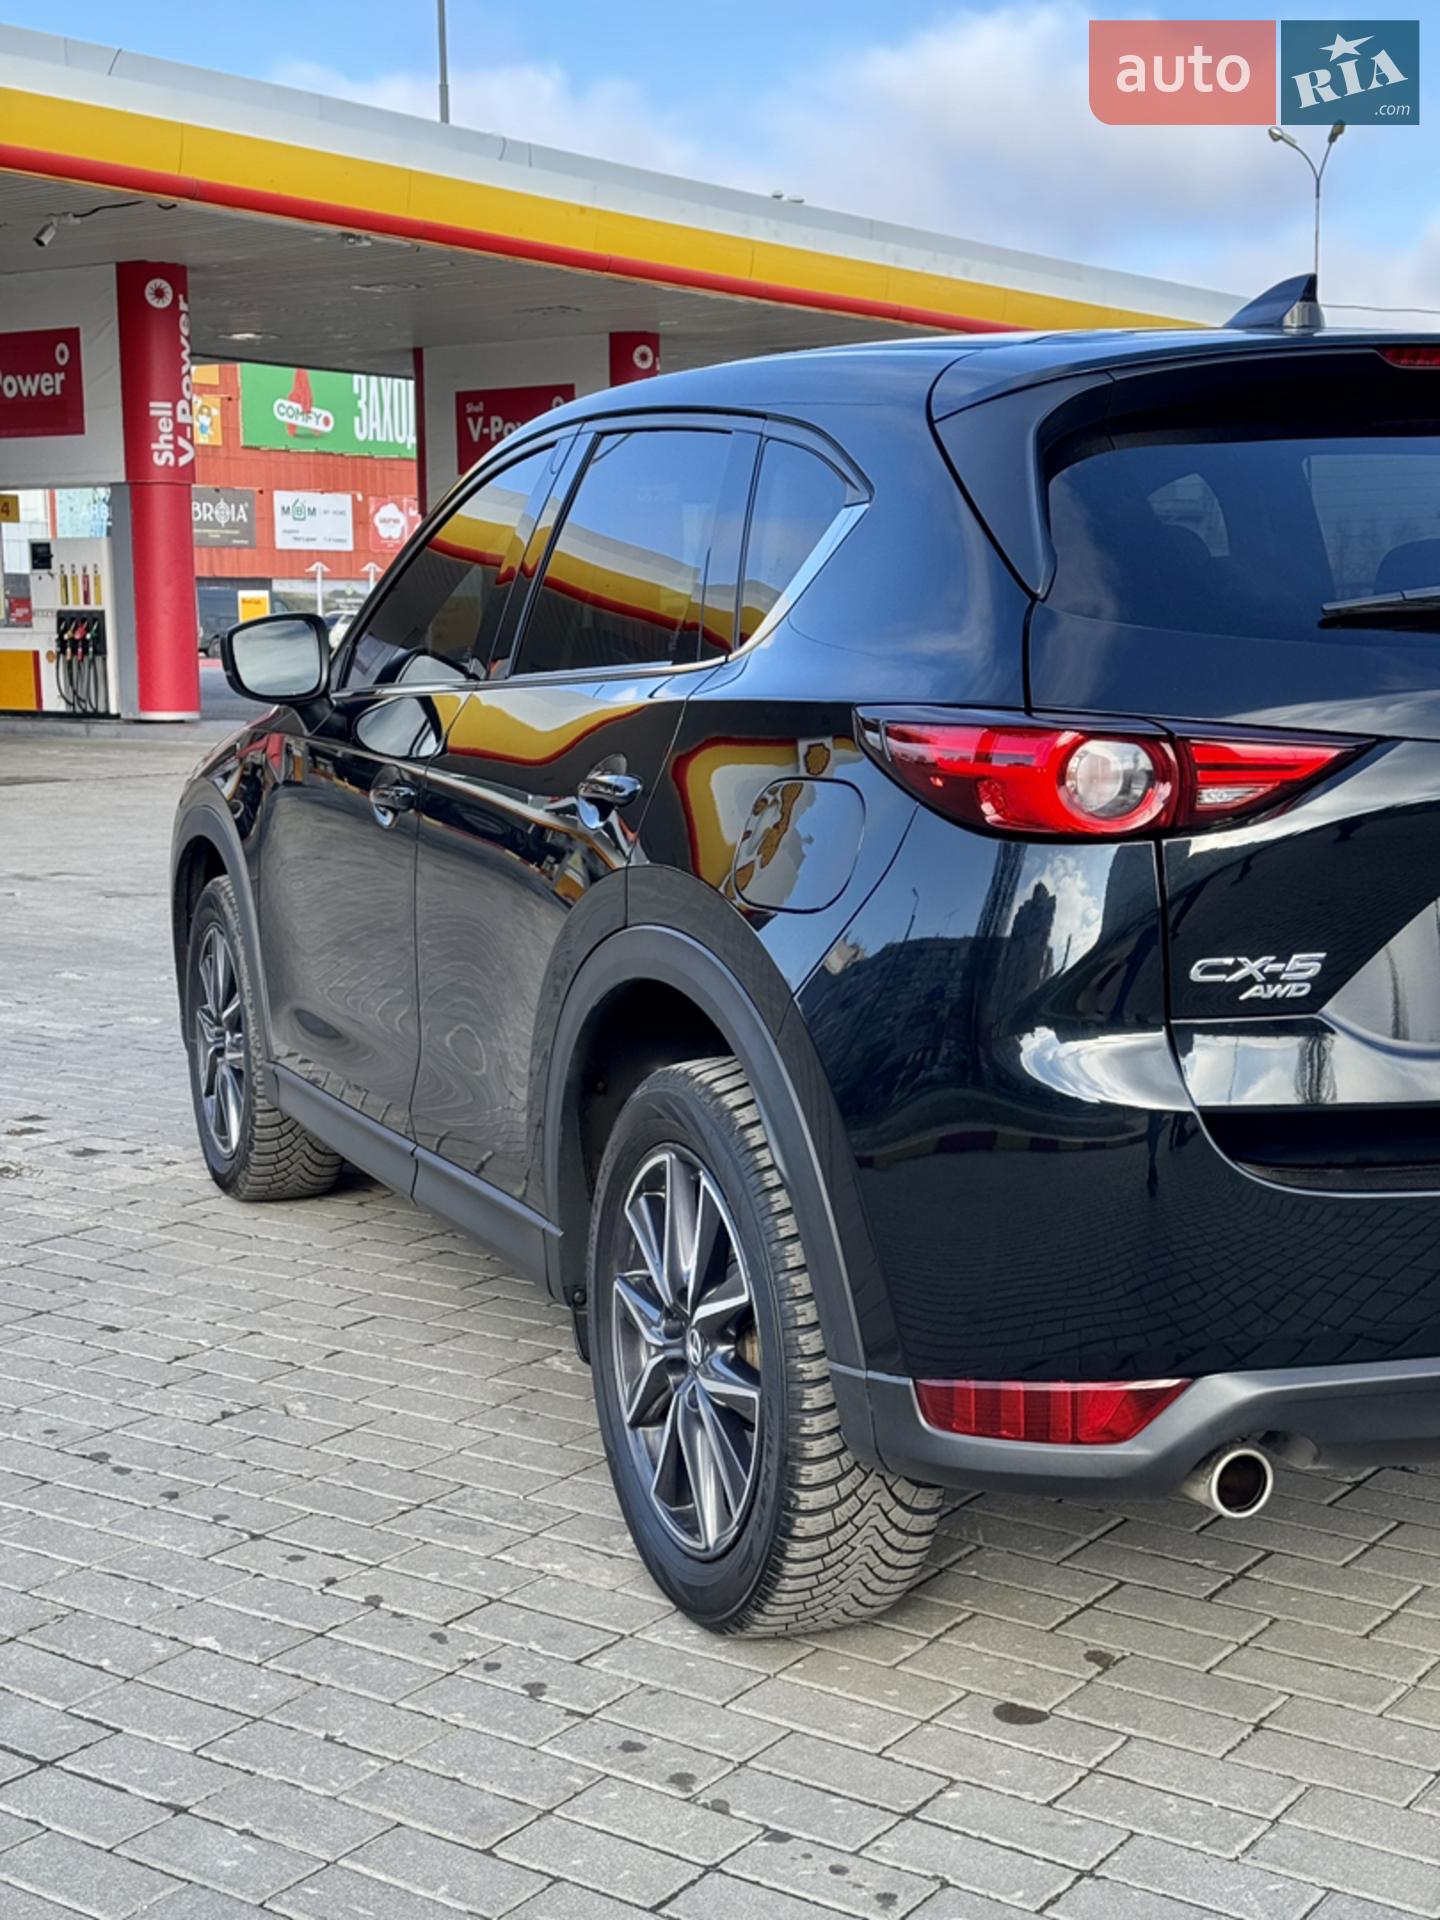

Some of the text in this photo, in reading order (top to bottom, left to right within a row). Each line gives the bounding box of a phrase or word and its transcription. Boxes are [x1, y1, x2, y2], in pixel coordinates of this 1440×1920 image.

[177, 293, 196, 467] V-Power
[277, 402, 322, 426] COMFY
[149, 401, 175, 467] Shell
[467, 415, 522, 442] V-Po
[1189, 952, 1327, 982] CX-5
[1238, 982, 1312, 1000] AWD
